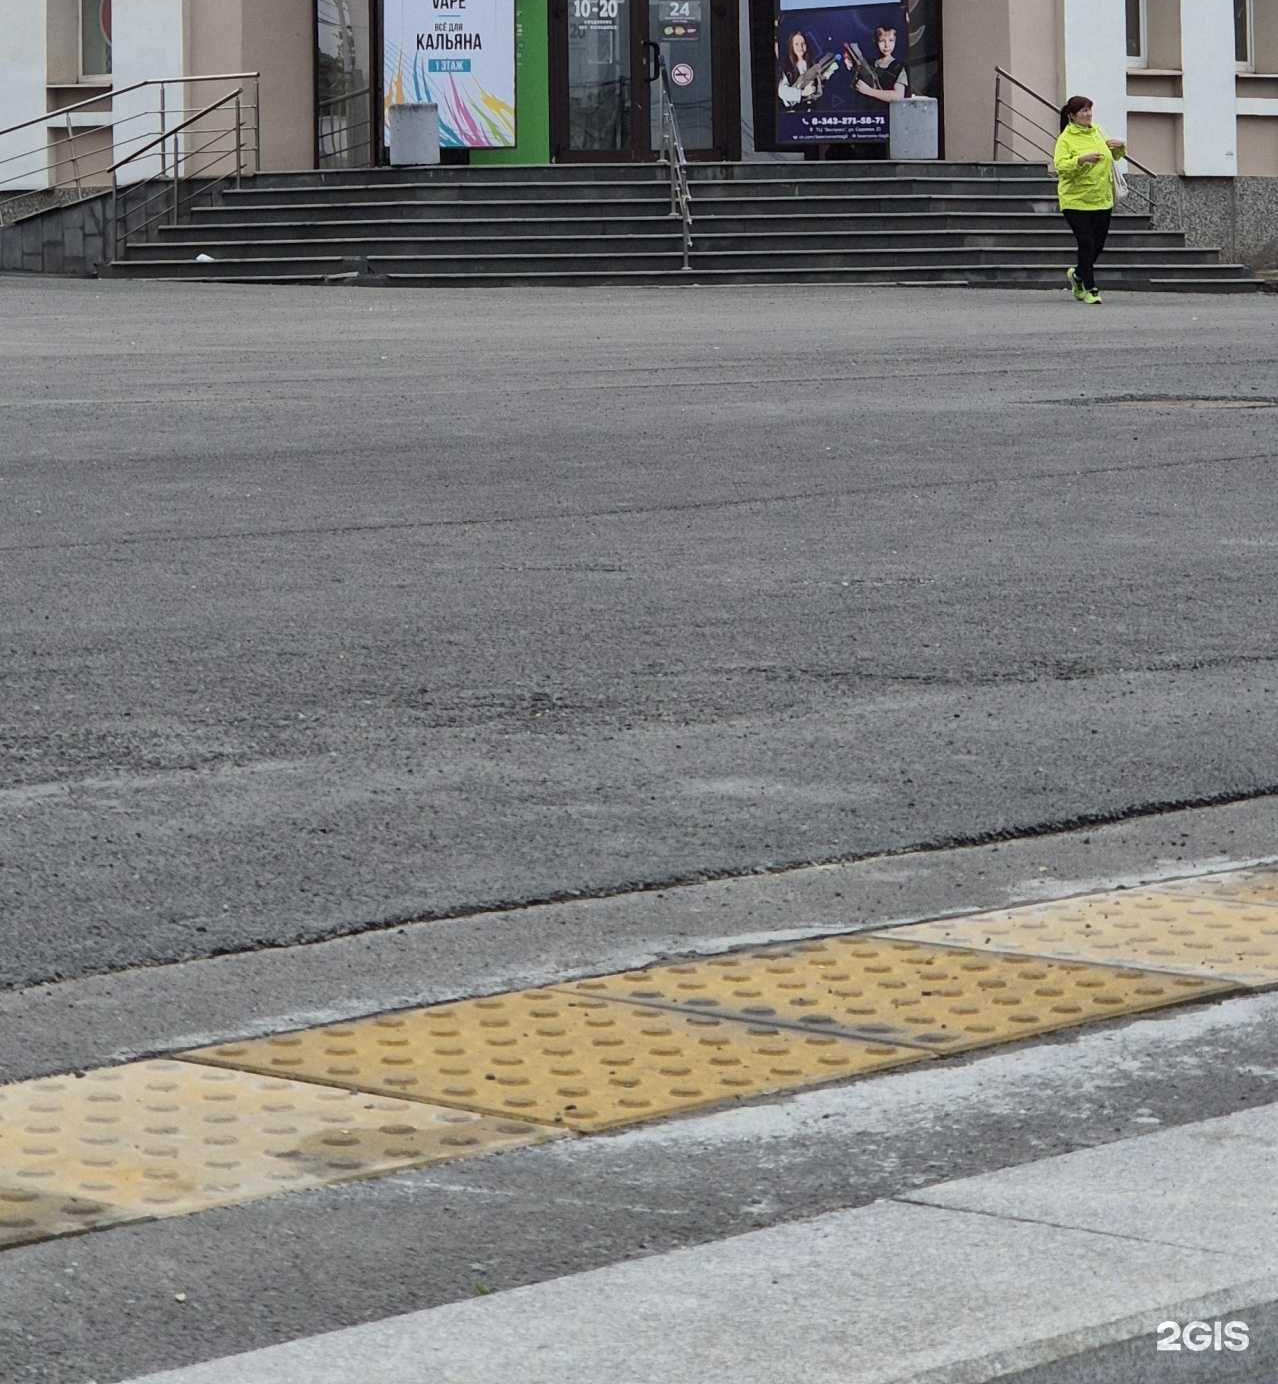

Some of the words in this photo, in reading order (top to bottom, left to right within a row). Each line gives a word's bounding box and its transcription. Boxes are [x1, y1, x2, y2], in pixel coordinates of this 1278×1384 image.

[670, 1, 690, 17] 24
[448, 23, 463, 33] ДЛЯ
[416, 32, 482, 51] КАЛЬЯНА
